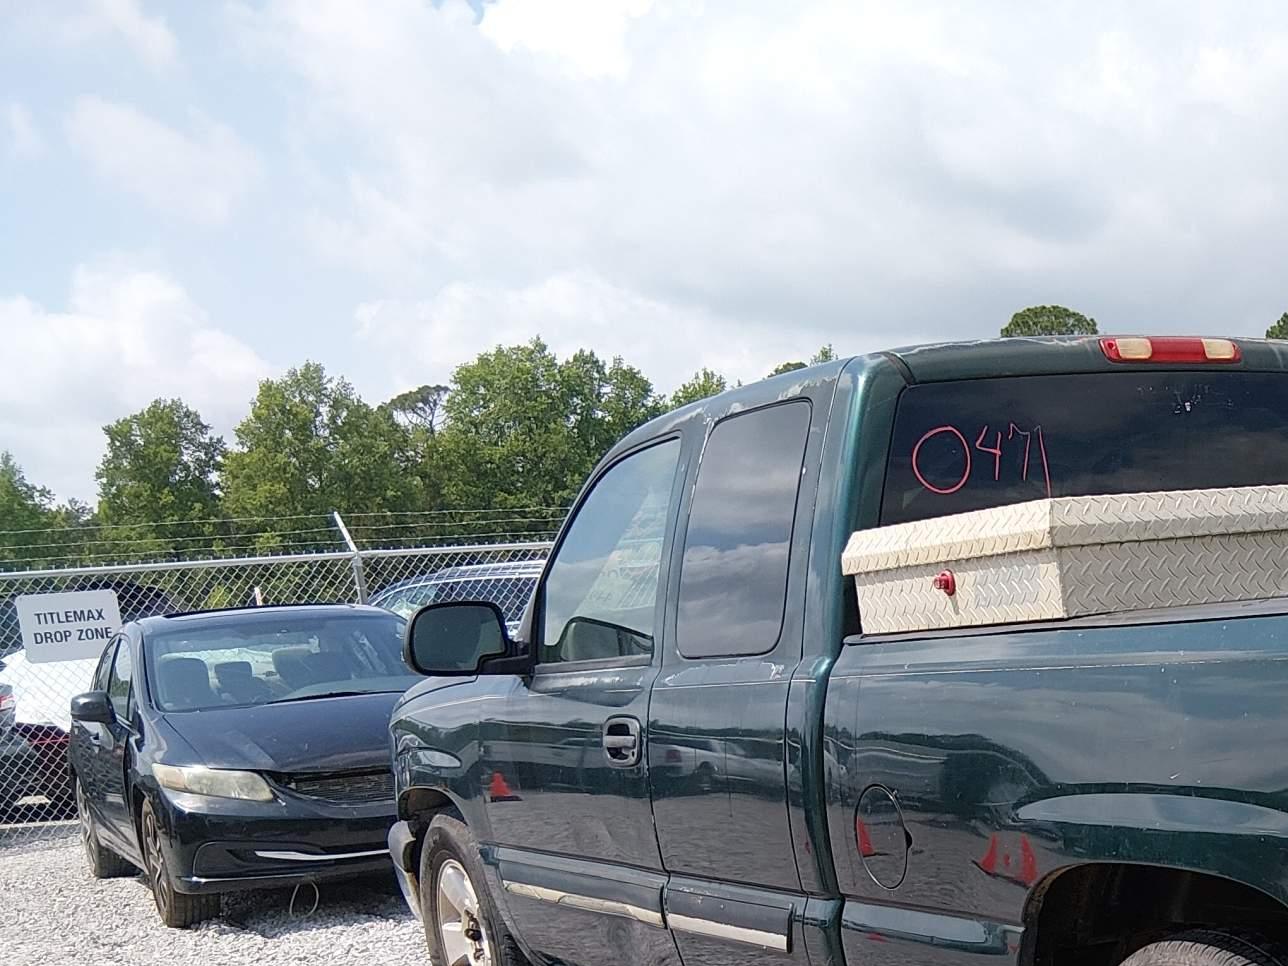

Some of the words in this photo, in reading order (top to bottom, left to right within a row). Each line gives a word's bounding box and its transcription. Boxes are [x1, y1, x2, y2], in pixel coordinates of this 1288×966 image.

[912, 423, 1051, 498] 0471
[34, 608, 105, 625] TITLEMAX
[33, 630, 72, 645] DROP
[77, 626, 113, 641] ZONE
